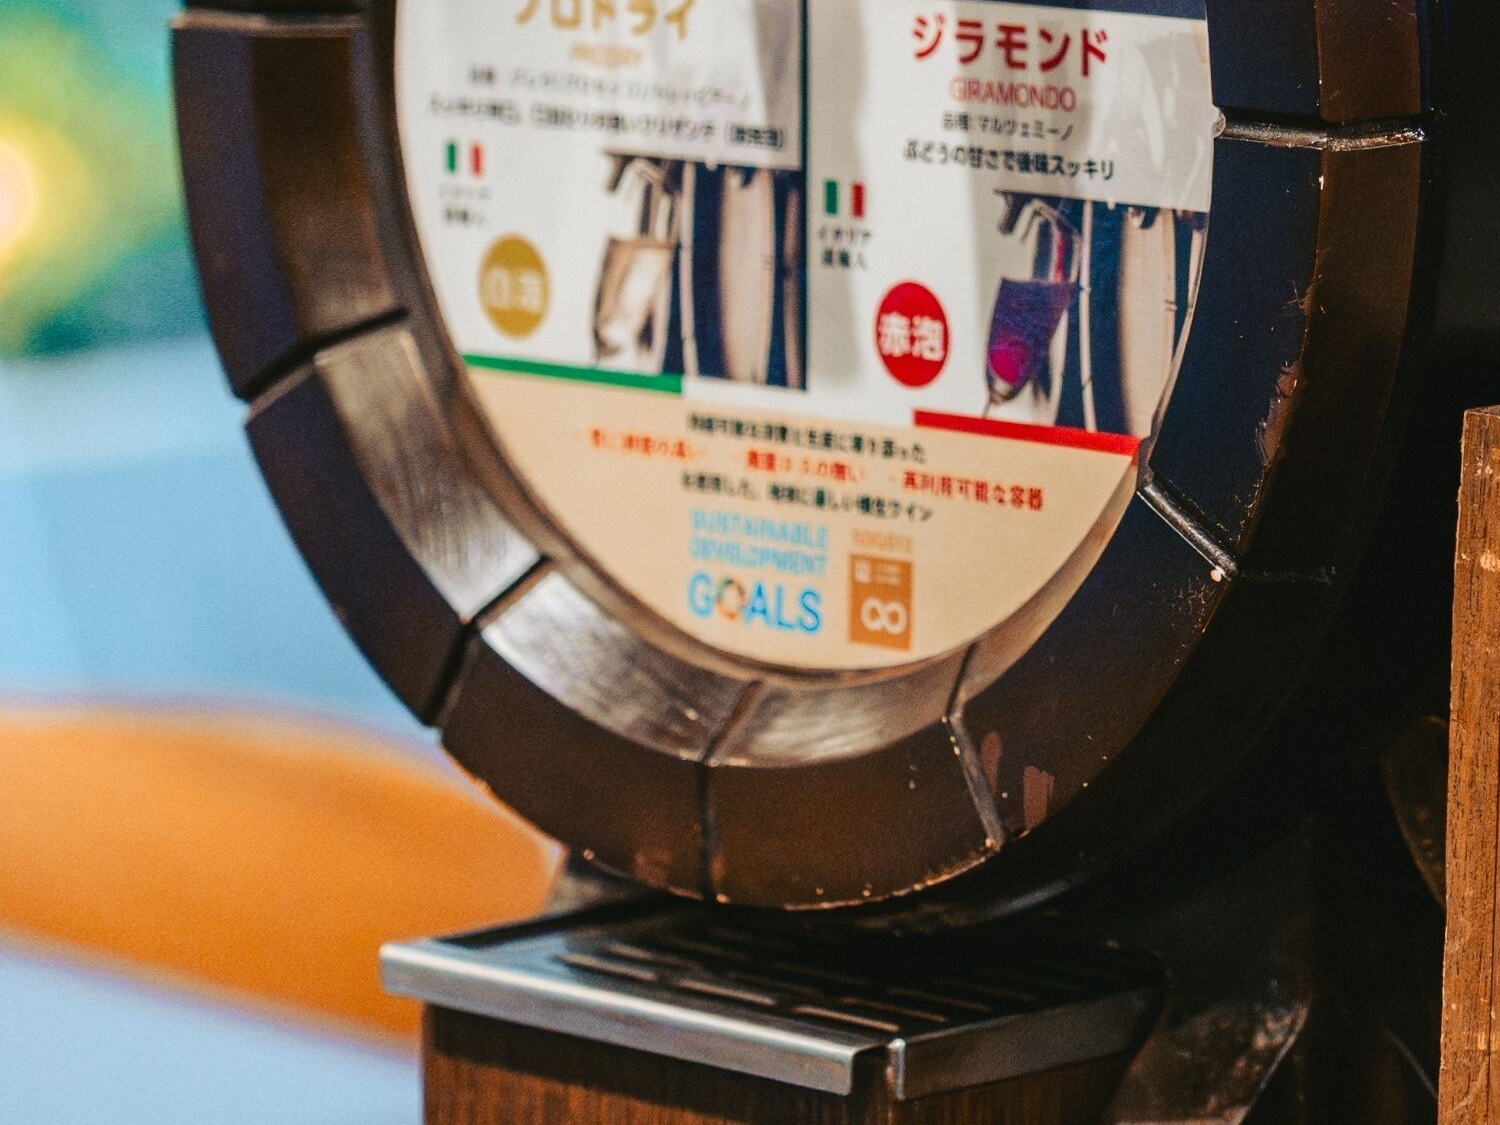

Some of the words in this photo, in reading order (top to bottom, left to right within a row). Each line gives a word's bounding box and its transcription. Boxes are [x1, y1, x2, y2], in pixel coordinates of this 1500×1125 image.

[913, 13, 1108, 78] ジラモンド
[949, 75, 1077, 112] GIRAMONDO
[878, 310, 945, 362] 赤泡
[687, 569, 824, 634] GOALS
